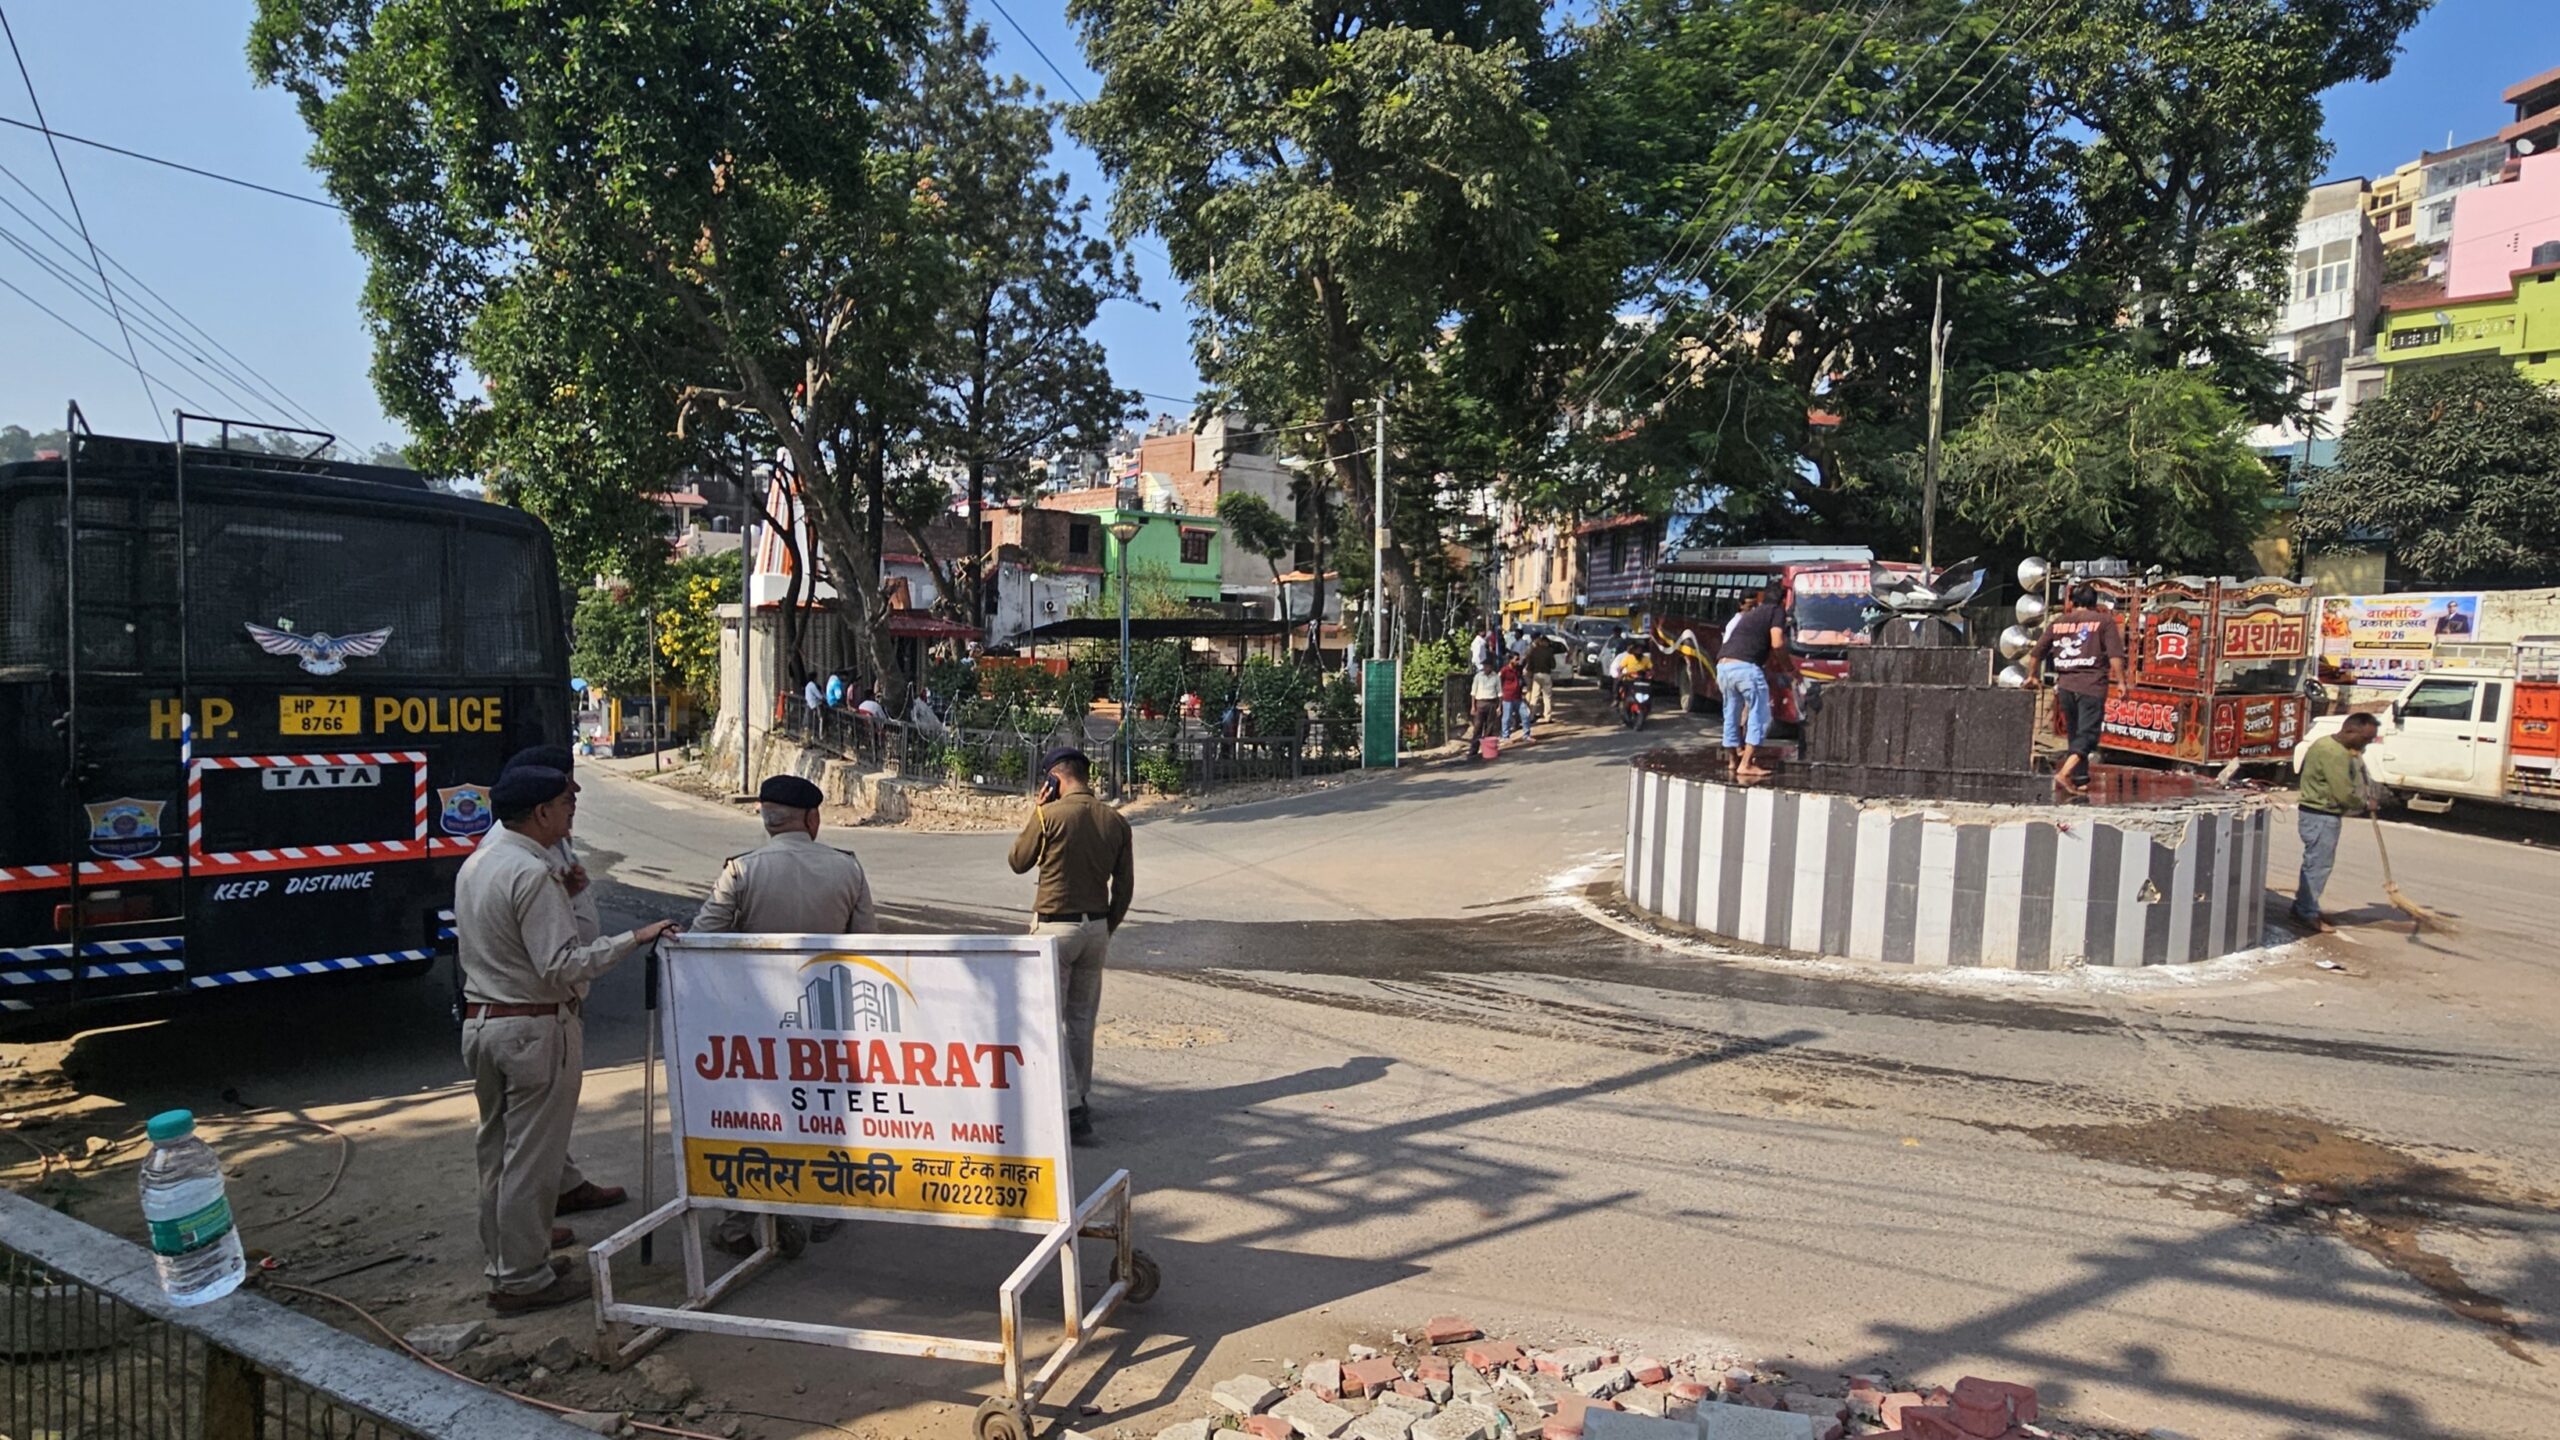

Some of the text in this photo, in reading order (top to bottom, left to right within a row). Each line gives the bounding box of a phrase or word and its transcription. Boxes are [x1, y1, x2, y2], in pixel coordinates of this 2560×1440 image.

[1807, 573, 1843, 588] VED
[2156, 633, 2188, 660] B
[2226, 618, 2300, 652] अशोक
[2377, 630, 2405, 640] 2026
[294, 699, 347, 714] HP 71
[374, 696, 502, 734] POLICE
[2104, 698, 2175, 732] SHOK
[301, 716, 343, 731] 8766
[271, 767, 373, 787] TATA
[213, 871, 375, 901] KEEP DISTANCE
[695, 1035, 1025, 1089] JAI BHARAT
[791, 1087, 914, 1115] STEEL
[711, 1109, 1006, 1144] HAMARA LOHA DUNIYA MANE
[703, 1147, 902, 1198] पुलिस चौकी
[912, 1157, 955, 1178] कच्चा
[999, 1162, 1043, 1185] नाहन
[921, 1181, 1028, 1208] 1702222397
